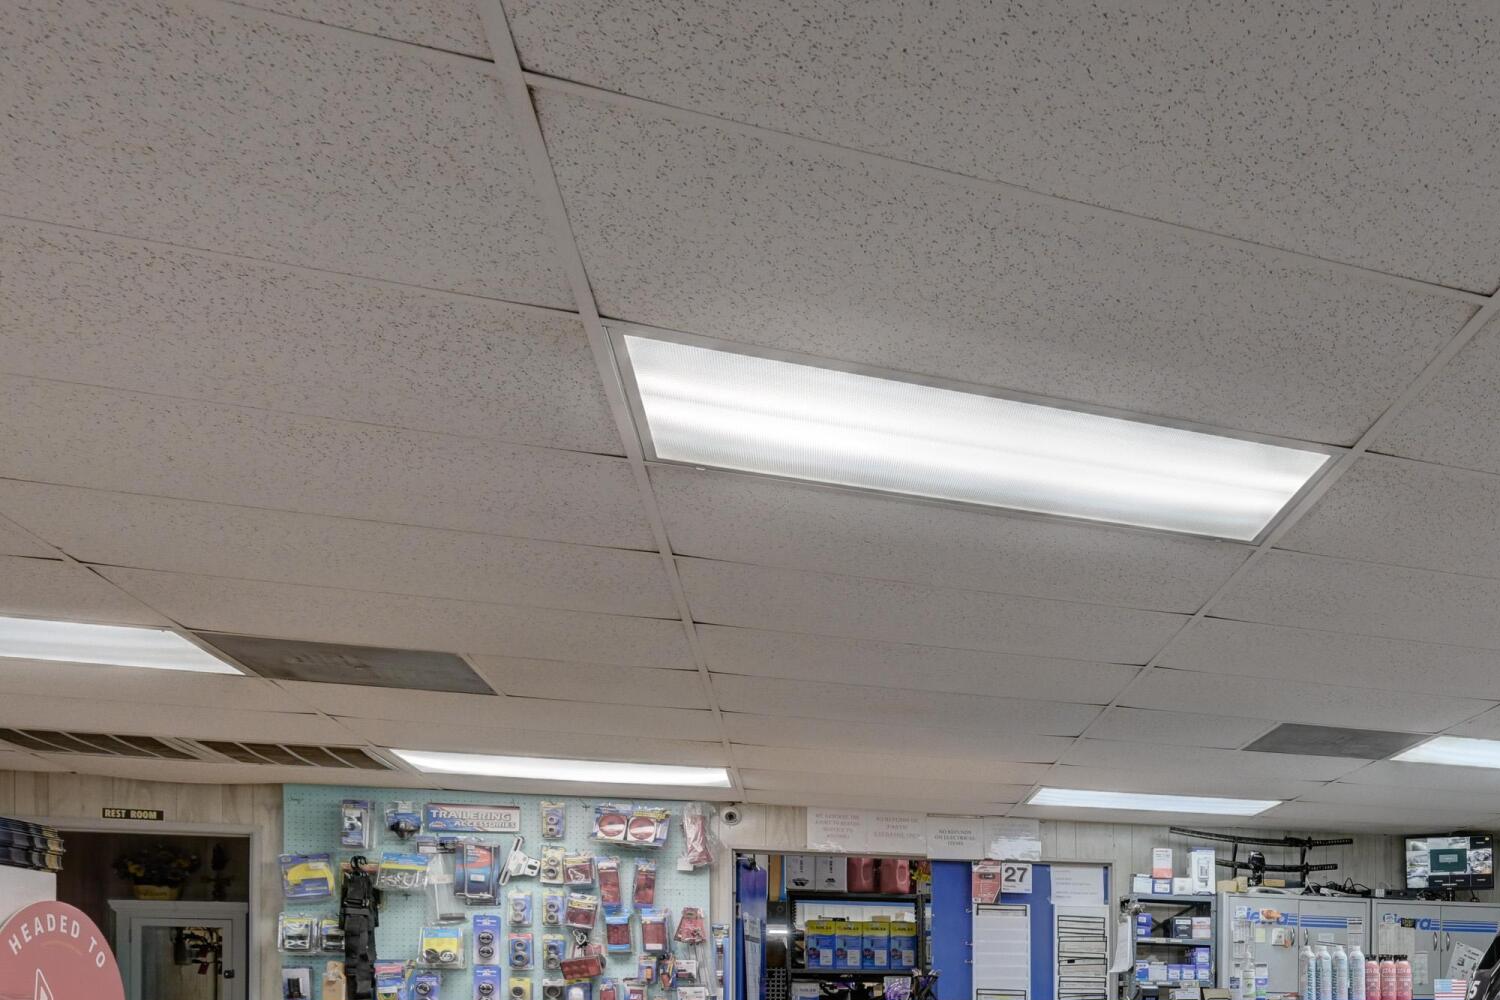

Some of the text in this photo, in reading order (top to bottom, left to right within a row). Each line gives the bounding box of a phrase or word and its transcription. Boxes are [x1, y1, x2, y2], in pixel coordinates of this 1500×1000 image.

[104, 809, 157, 819] REST ROOM
[430, 809, 512, 821] TRAILERING
[454, 820, 516, 829] ACCESSORIES
[1004, 866, 1028, 882] 27
[8, 913, 106, 969] HEADED TO
